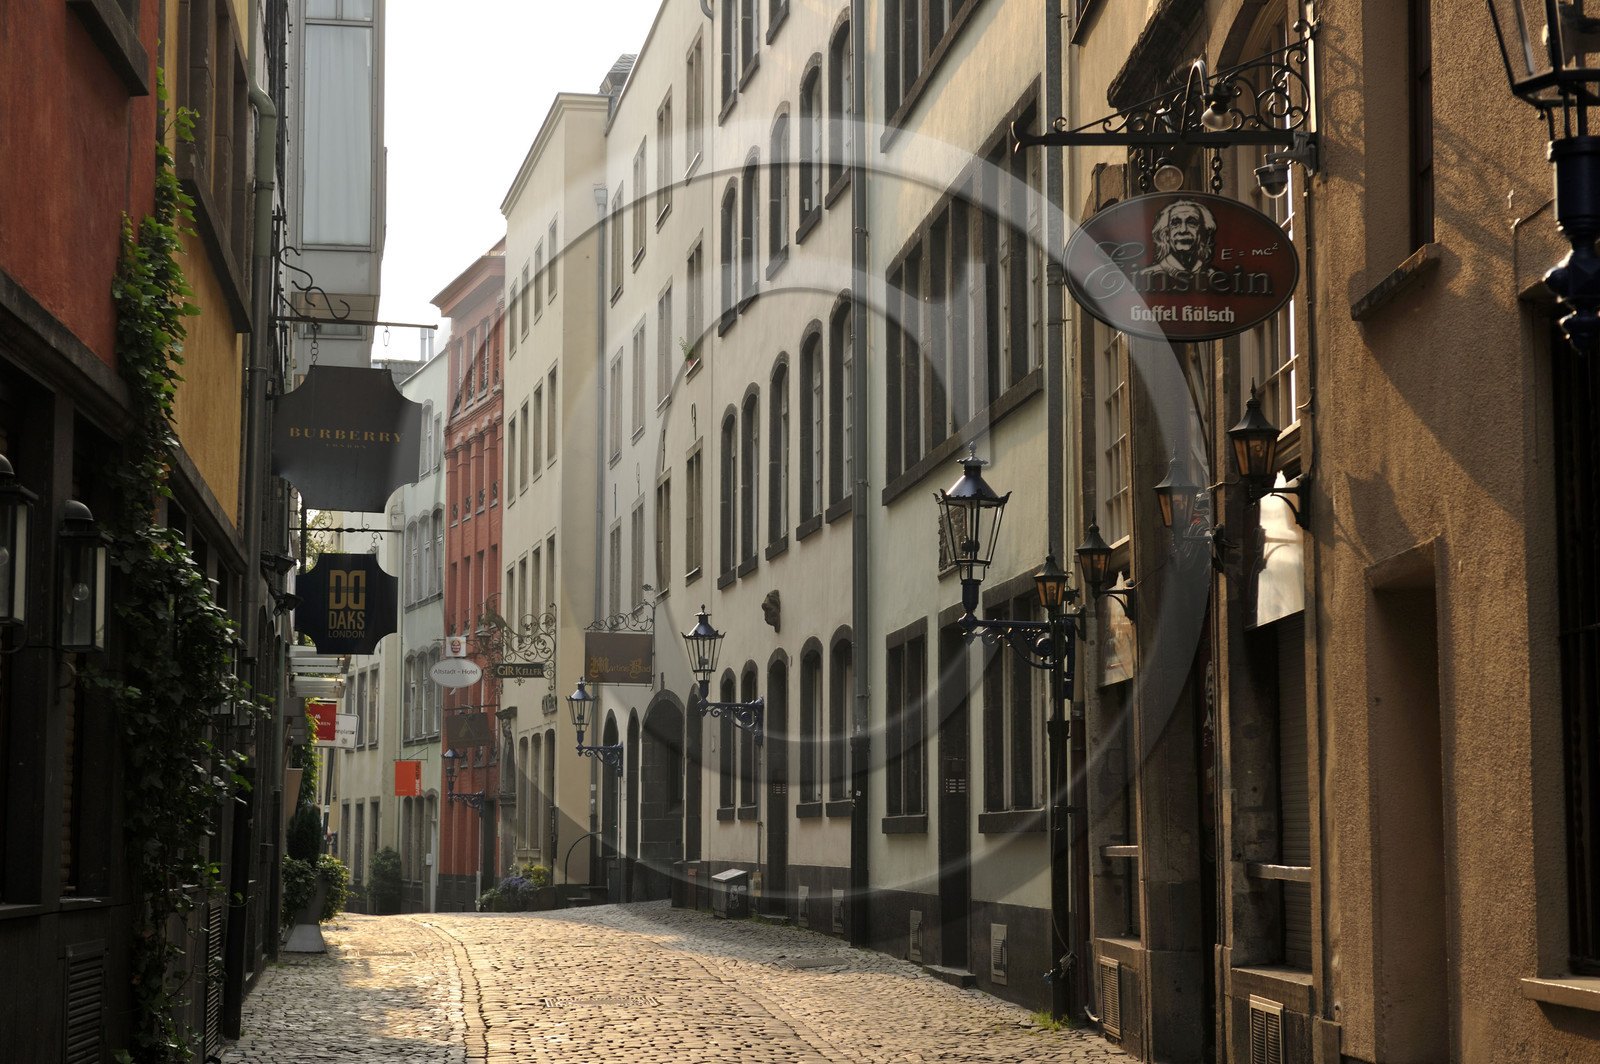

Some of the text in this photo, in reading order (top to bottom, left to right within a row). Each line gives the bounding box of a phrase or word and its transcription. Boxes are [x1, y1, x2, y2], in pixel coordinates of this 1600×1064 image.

[1221, 248, 1233, 260] E
[1084, 242, 1275, 299] Einstein
[1130, 305, 1235, 324] Gaffel Kölsch
[289, 427, 404, 443] BURBERRY
[328, 611, 365, 630] DAKS
[328, 630, 365, 638] LONDON
